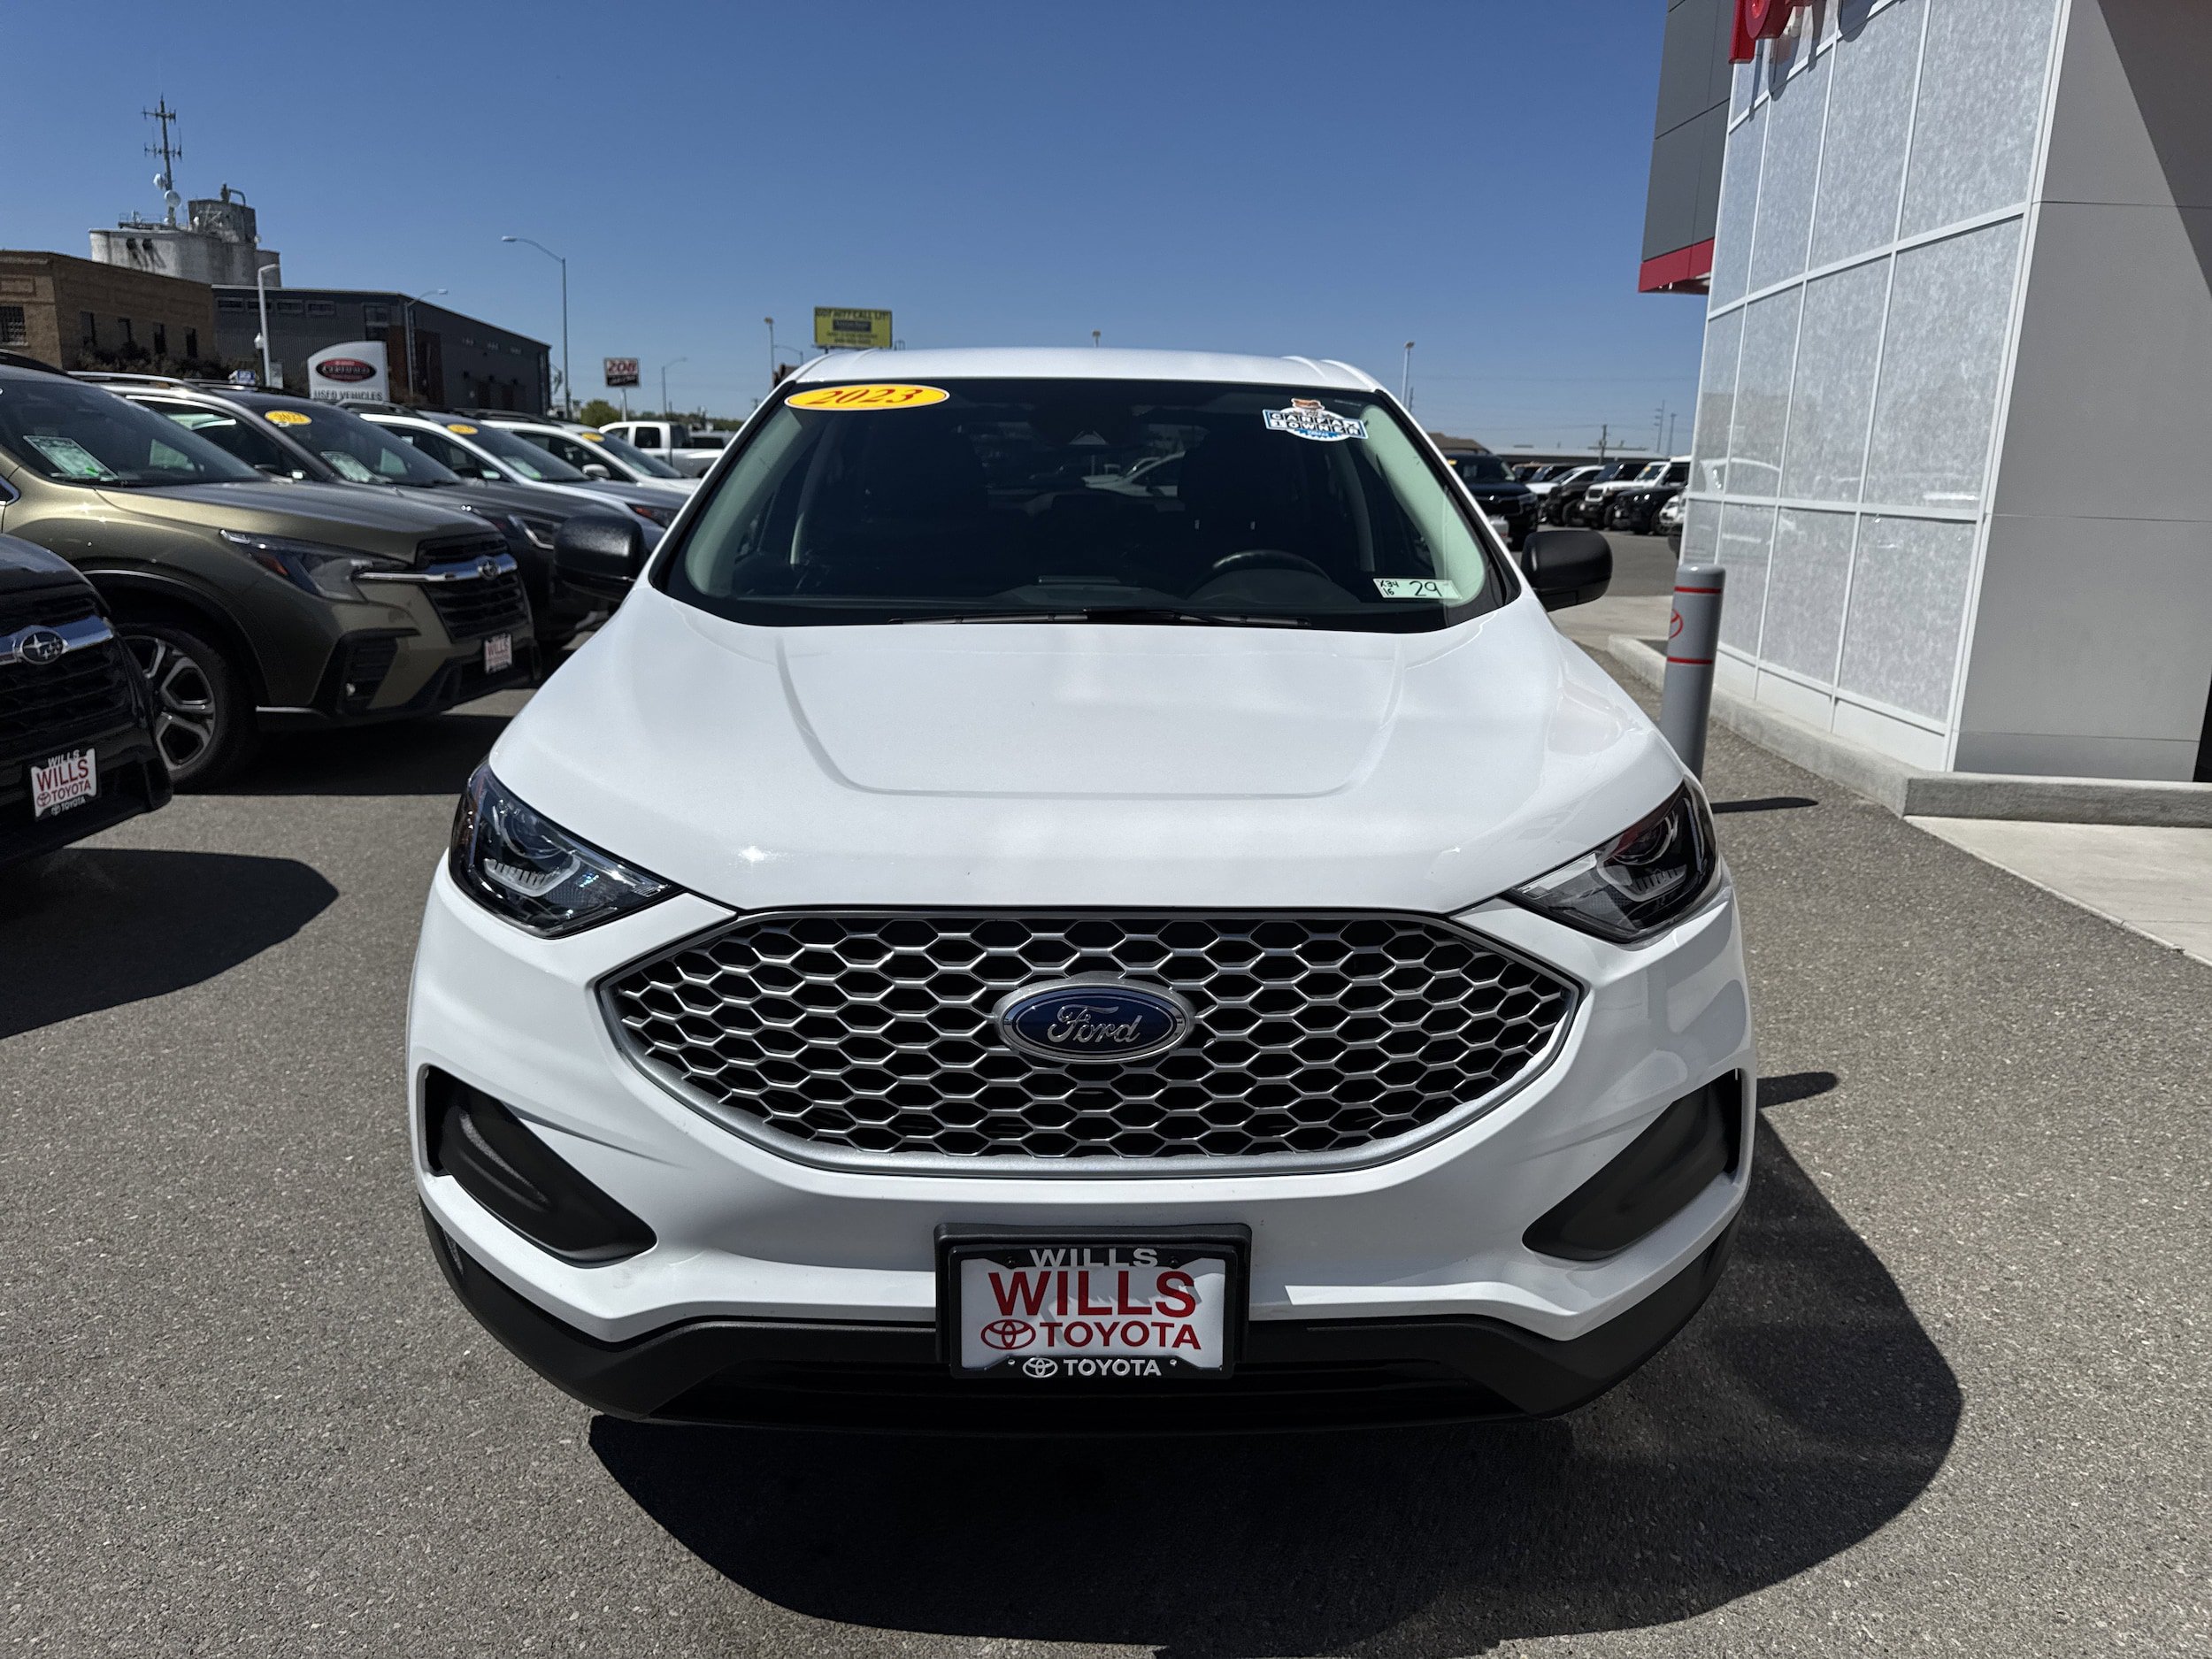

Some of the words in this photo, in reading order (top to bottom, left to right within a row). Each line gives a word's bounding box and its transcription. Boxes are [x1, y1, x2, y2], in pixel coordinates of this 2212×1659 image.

[314, 389, 336, 398] USED
[340, 390, 383, 401] VEHICLES
[806, 388, 924, 405] 2023
[1271, 412, 1360, 429] CARFAX
[1288, 422, 1359, 435] OWNER
[1409, 580, 1443, 597] 29
[47, 749, 81, 768] WILLS
[36, 758, 89, 792] WILLS
[51, 779, 92, 803] TOYOTA
[61, 796, 86, 811] TOYOTA
[1047, 1003, 1143, 1043] Ford
[1029, 1248, 1158, 1268] WILLS
[988, 1270, 1197, 1318] WILLS
[1039, 1320, 1202, 1350] TOYOTA
[1063, 1359, 1162, 1377] TOYOTA
